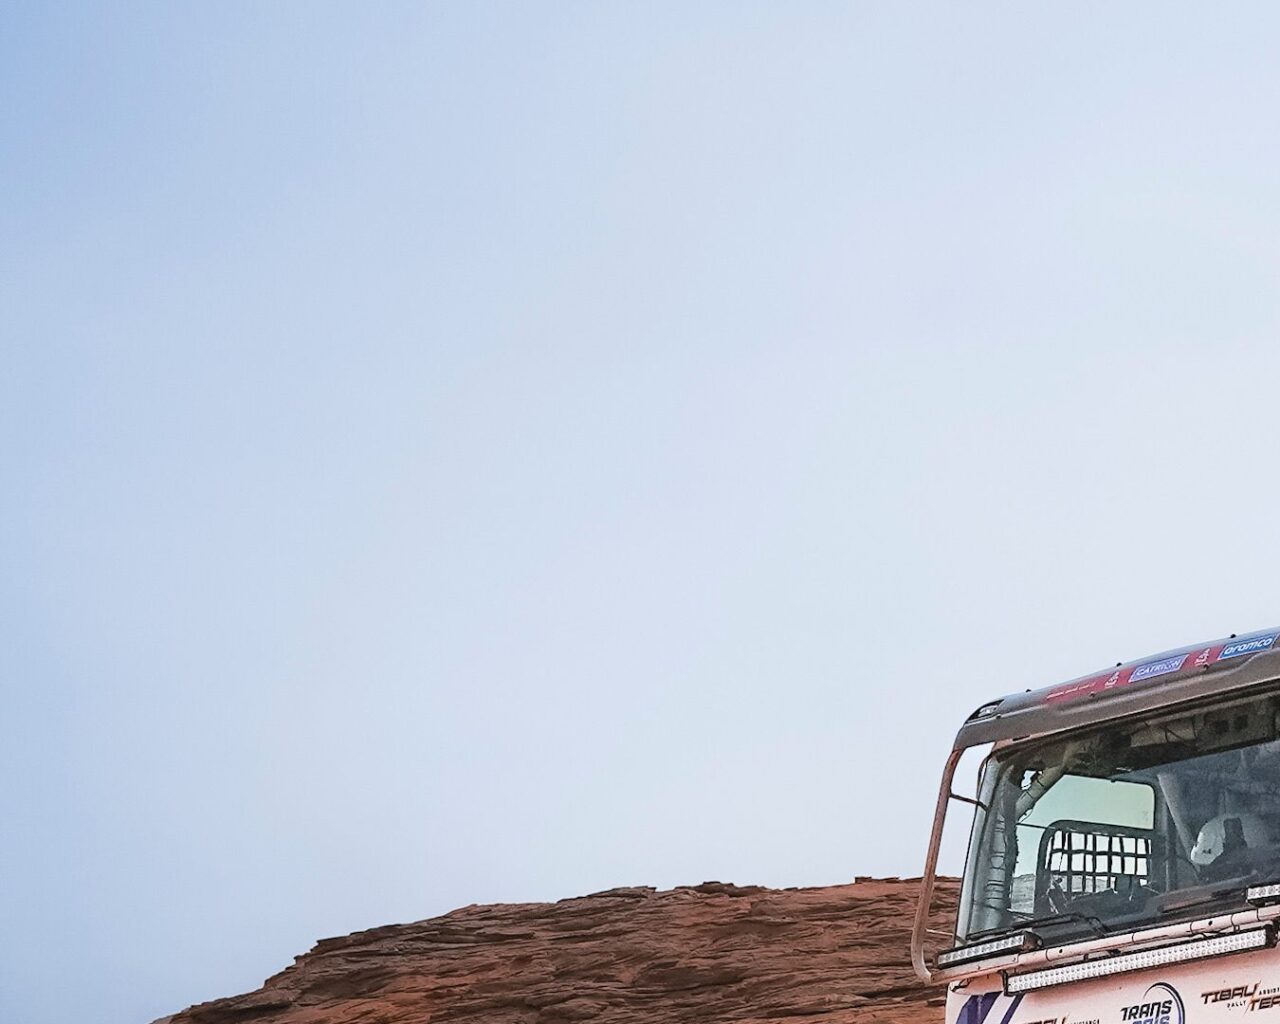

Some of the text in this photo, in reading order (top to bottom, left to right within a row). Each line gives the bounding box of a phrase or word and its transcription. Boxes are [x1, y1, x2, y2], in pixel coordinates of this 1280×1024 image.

[1224, 637, 1273, 655] aramco
[1201, 983, 1259, 1004] TIBAU
[1120, 999, 1173, 1021] TRANS
